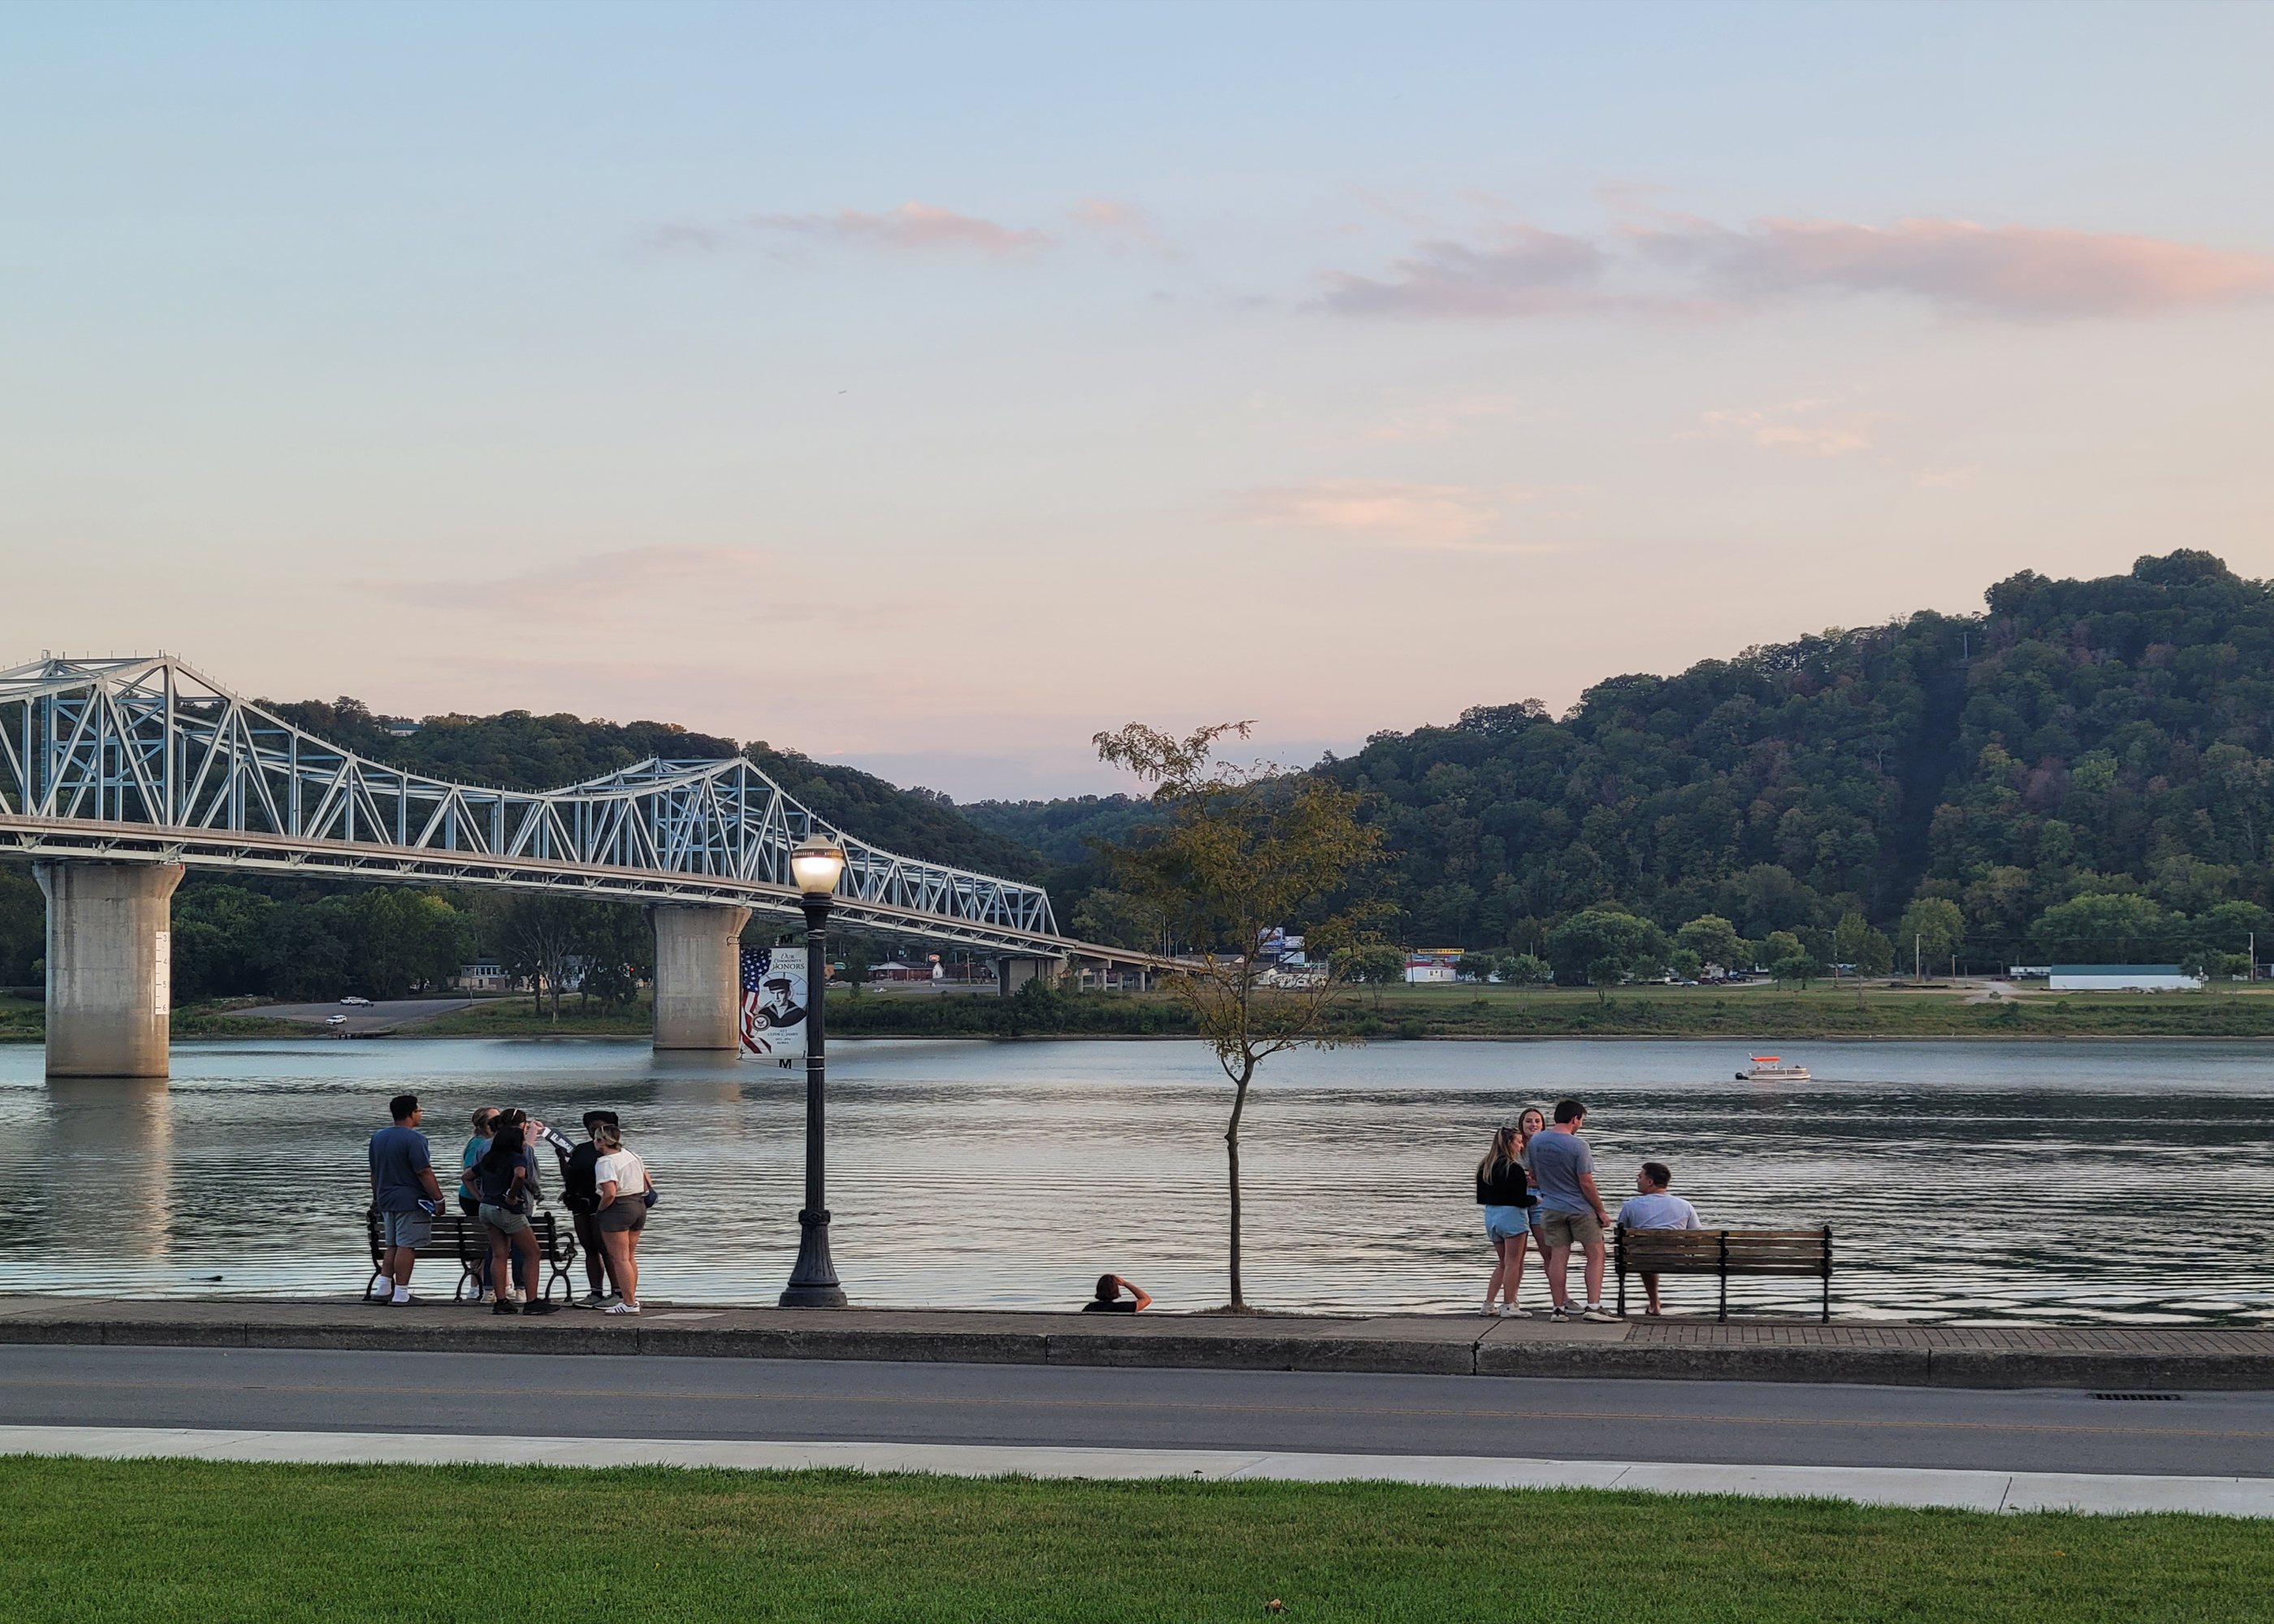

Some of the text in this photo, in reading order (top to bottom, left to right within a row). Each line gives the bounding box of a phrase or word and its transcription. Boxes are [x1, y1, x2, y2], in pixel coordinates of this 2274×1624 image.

[771, 962, 805, 971] HONORS
[162, 1004, 166, 1012] 6
[779, 1059, 792, 1069] M
